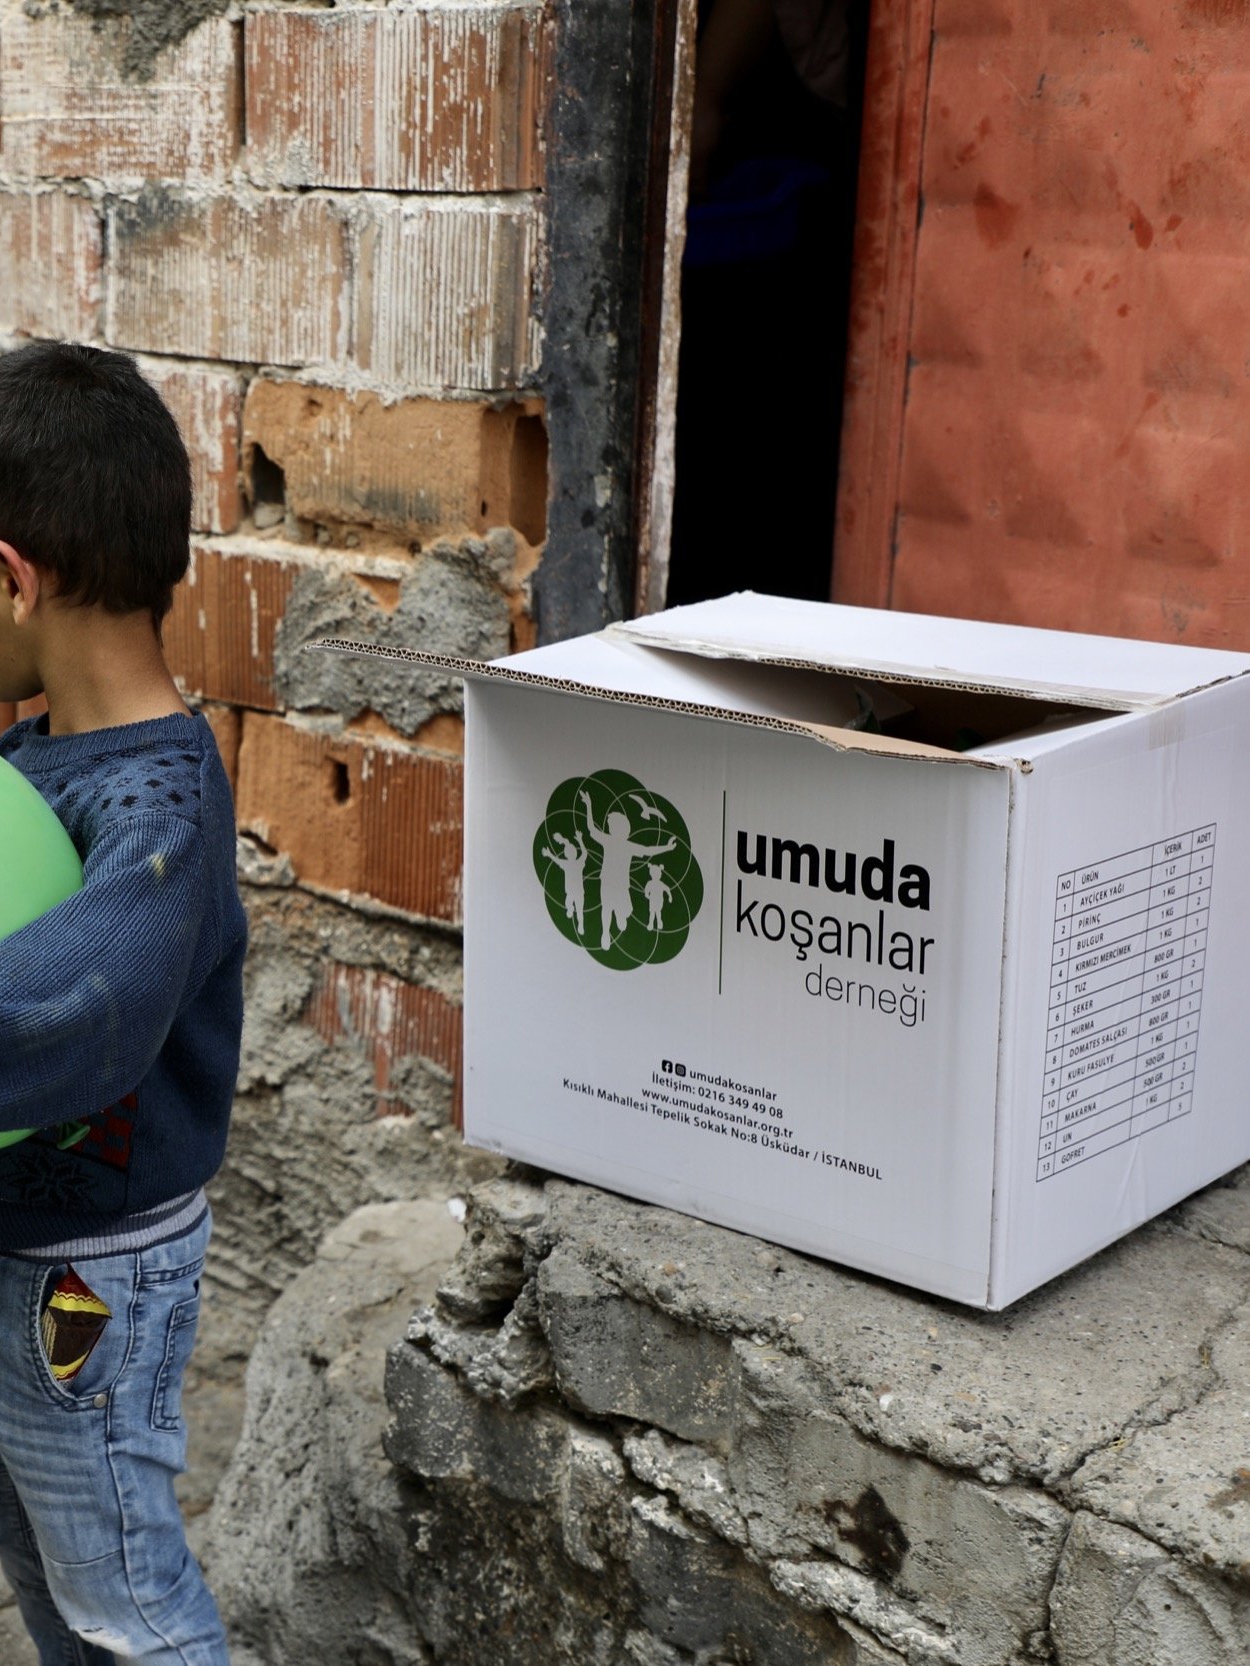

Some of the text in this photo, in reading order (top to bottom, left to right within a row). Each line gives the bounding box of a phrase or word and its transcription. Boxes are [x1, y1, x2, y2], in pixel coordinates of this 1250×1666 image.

[736, 830, 930, 911] umuda
[1061, 880, 1071, 890] NO
[1082, 870, 1099, 884] ÜRÜN
[1196, 832, 1212, 844] ADET
[1078, 913, 1101, 928] PİRİNÇ
[1168, 886, 1176, 896] KG
[1080, 888, 1108, 906] AYÇİÇEK
[1110, 884, 1125, 896] YAĞI
[1170, 865, 1176, 875] LT
[736, 878, 935, 974] koşanlar
[1075, 955, 1099, 972] KIRMIZI
[1100, 944, 1131, 963] MERCİMEK
[1164, 928, 1172, 938] KG
[1077, 933, 1104, 950] BULGUR
[1166, 907, 1174, 918] KG
[806, 963, 926, 1027] derneği
[1072, 1000, 1094, 1016] ŞEKER
[1160, 970, 1169, 980] KG
[1074, 982, 1087, 994] TUZ
[1166, 948, 1174, 959] GR
[1069, 1038, 1100, 1058] DOMATES
[1101, 1027, 1127, 1044] SALÇASI
[1161, 1011, 1168, 1022] GR
[1071, 1020, 1094, 1037] HURMA
[1163, 989, 1170, 1000] GR
[1068, 1066, 1085, 1080] KURU
[1087, 1053, 1115, 1073] FASULYE
[1155, 1032, 1163, 1042] KG
[652, 1071, 783, 1119] İletişim: 0216 349 49 08
[690, 1070, 777, 1101] umudakosanlar
[1046, 1120, 1053, 1130] 11
[1064, 1102, 1097, 1122] MAKARNA
[1155, 1072, 1163, 1083] GR
[1048, 1099, 1056, 1110] 10
[1066, 1088, 1078, 1102] ÇAY
[1157, 1052, 1165, 1063] GR
[563, 1078, 594, 1096] Kısıklı
[597, 1088, 648, 1112] Mahallesi
[650, 1104, 690, 1124] Tepelik
[694, 1117, 727, 1135] Sokak
[731, 1127, 758, 1144] No:8
[761, 1135, 810, 1159] Üsküdar
[822, 1150, 882, 1180] İSTANBUL
[642, 1088, 793, 1139] www.umudakosanlar.org.tr
[1044, 1141, 1051, 1151] 12
[1063, 1132, 1072, 1143] UN
[1150, 1094, 1158, 1104] KG
[1043, 1162, 1050, 1172] 13
[1061, 1146, 1085, 1164] GOFRET
